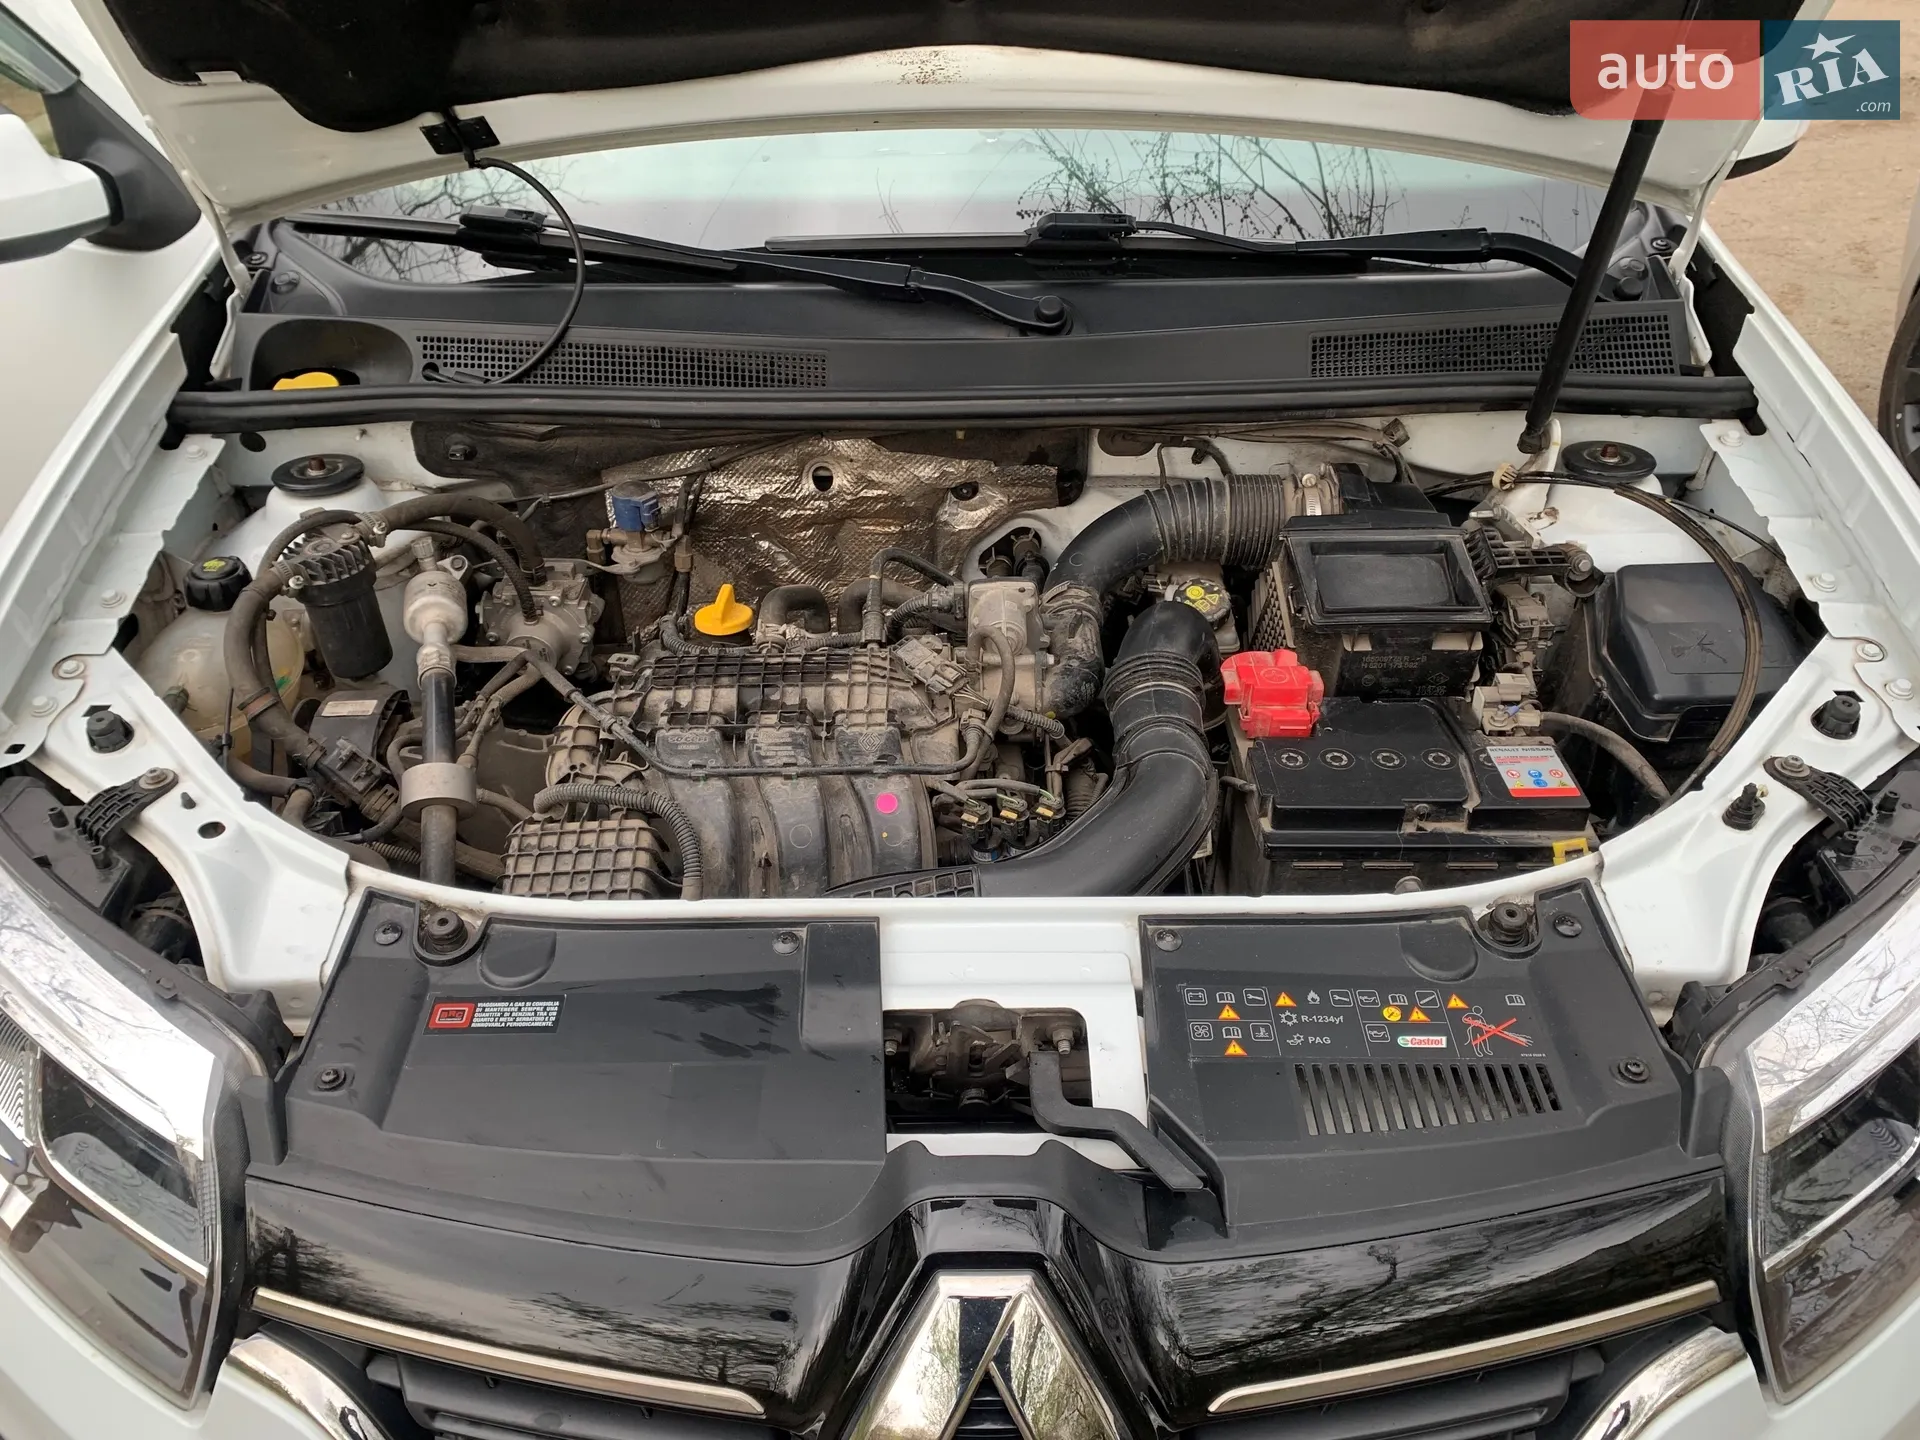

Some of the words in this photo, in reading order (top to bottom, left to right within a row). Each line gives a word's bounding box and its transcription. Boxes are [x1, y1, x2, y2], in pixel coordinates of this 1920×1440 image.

[440, 1010, 464, 1018] BRC
[1301, 1015, 1344, 1024] R-1234yf
[1308, 1036, 1331, 1044] PAG
[1410, 1036, 1444, 1047] Castrol
